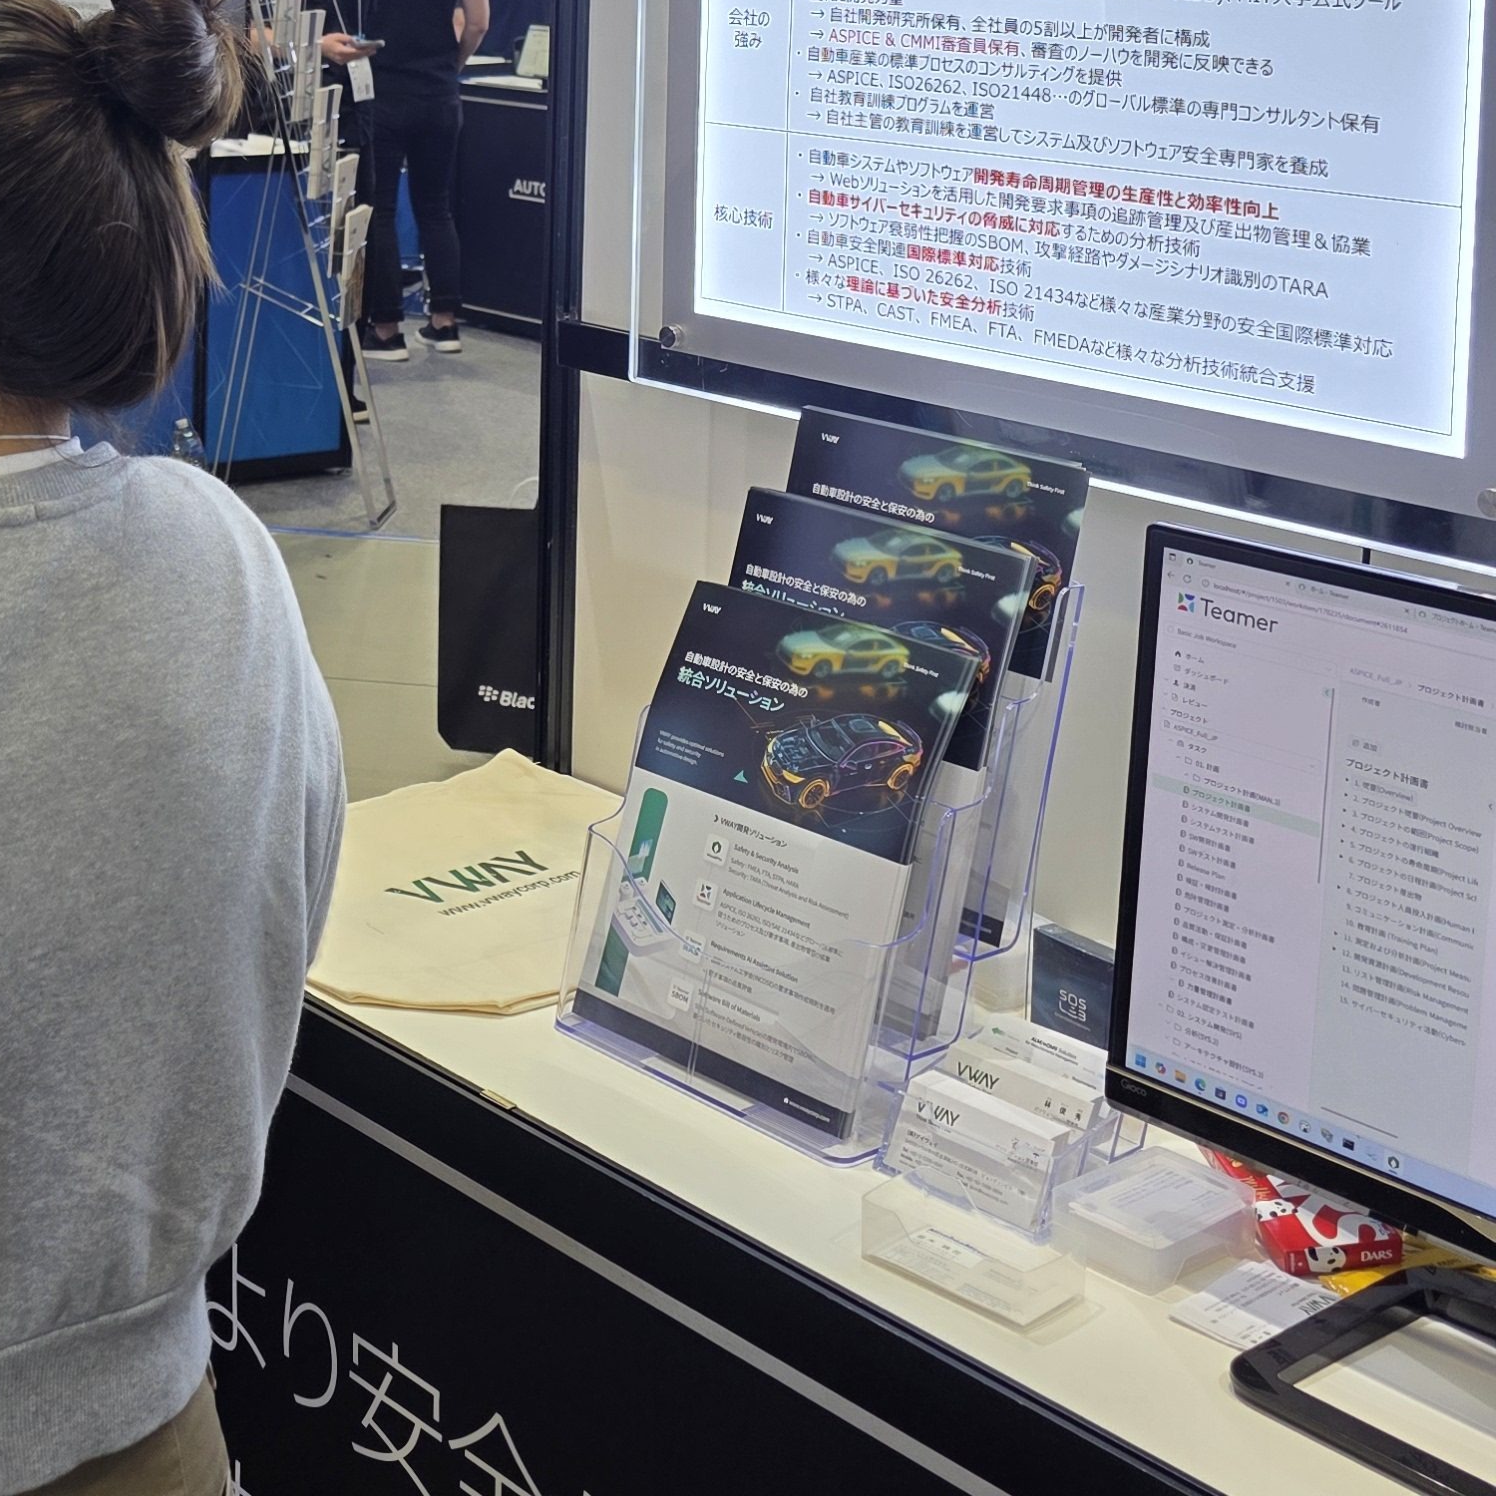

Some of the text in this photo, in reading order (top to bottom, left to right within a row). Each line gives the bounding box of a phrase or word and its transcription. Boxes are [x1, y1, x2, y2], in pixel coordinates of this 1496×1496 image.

[728, 7, 770, 28] 会社の
[734, 30, 762, 50] 強み
[828, 28, 880, 47] ASPICE
[884, 32, 896, 47] &
[810, 86, 995, 120] 自社教育訓練プログラムを運営
[713, 204, 773, 230] 核心技術
[807, 229, 1032, 279] 自動車安全関連国際標準対応技術
[805, 270, 1034, 322] 様々な理論に基づいた安全分析技術
[893, 262, 920, 280] ISO
[990, 278, 1018, 297] ISO
[811, 482, 935, 524] 自動車設計の安全と保安の為の
[745, 563, 867, 608] 自動車設計の安全と保安の為の
[1200, 596, 1279, 633] Teamer
[676, 665, 785, 713] 統合ソリューション
[684, 650, 809, 700] 自動車設計の安全と保安の為の
[1170, 708, 1208, 724] プロジェクト
[1345, 757, 1429, 790] プロジェクト計画書
[385, 849, 550, 905] VWAY
[958, 1061, 1000, 1090] VWAY
[1360, 1248, 1393, 1263] DARS
